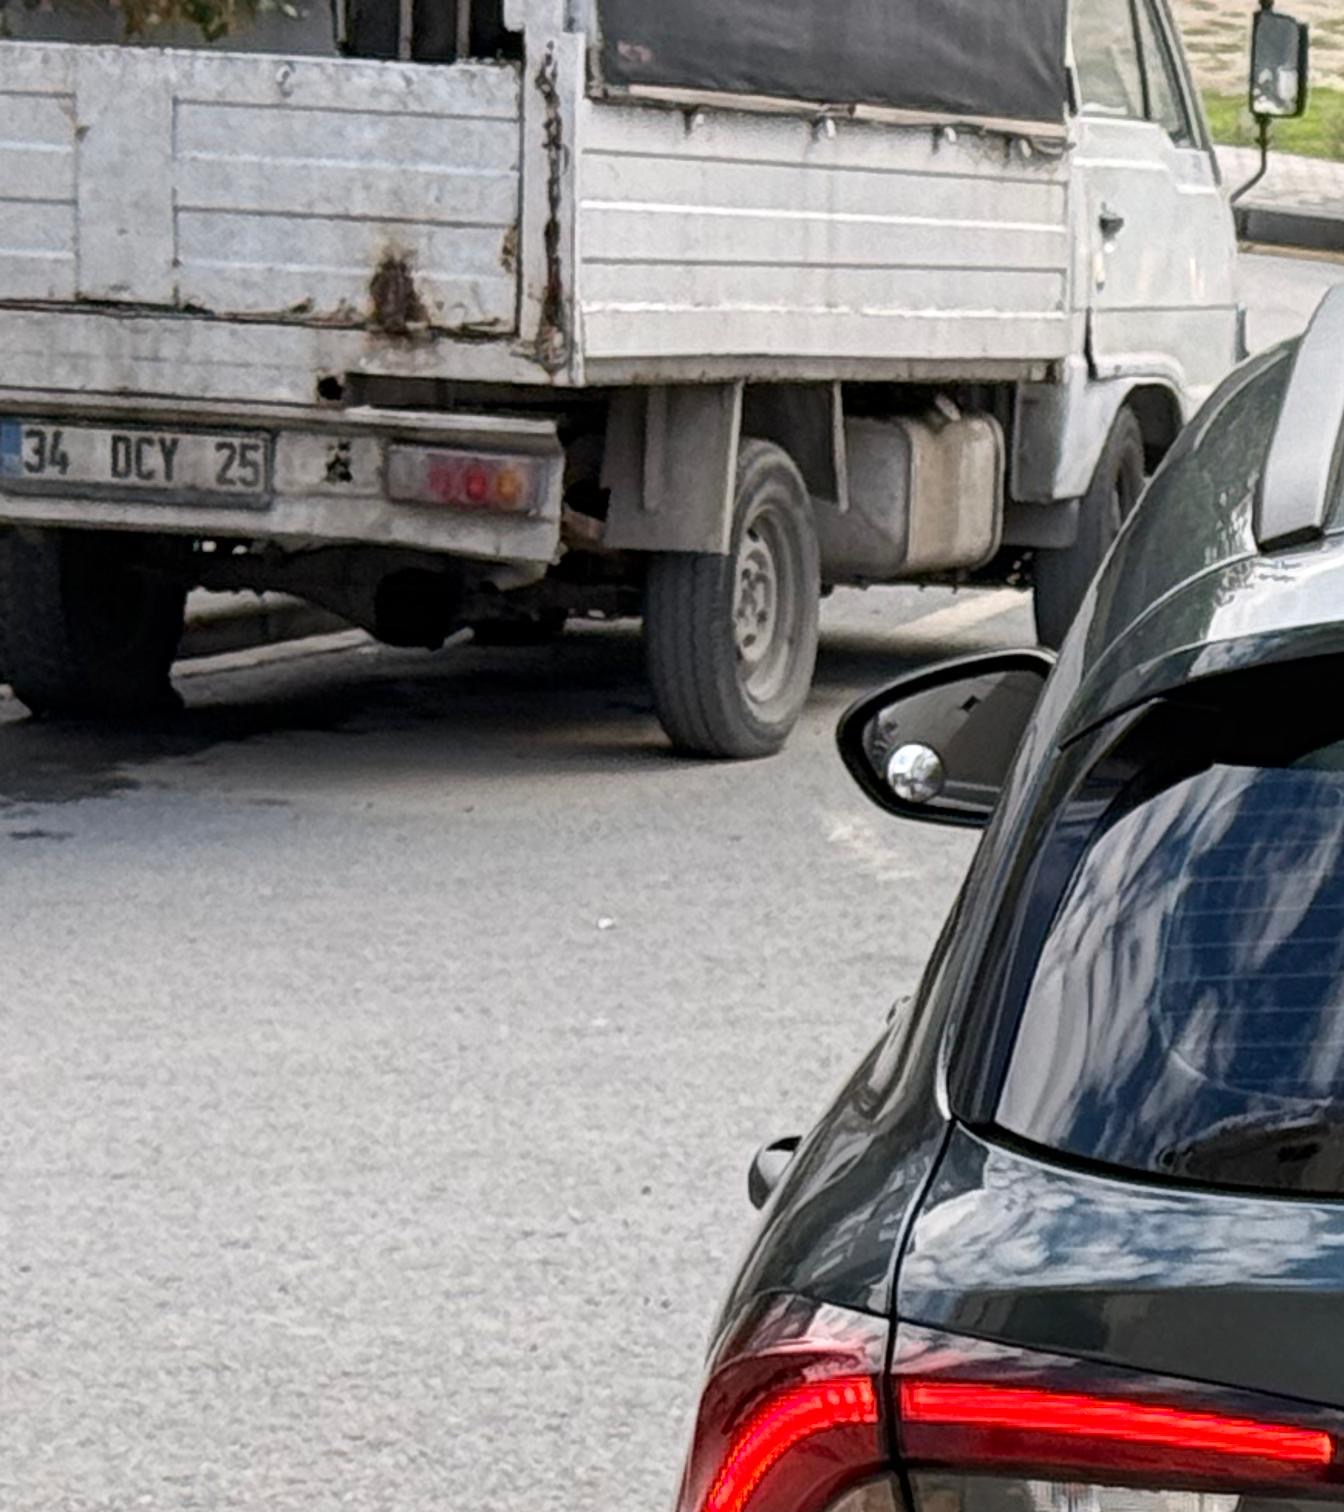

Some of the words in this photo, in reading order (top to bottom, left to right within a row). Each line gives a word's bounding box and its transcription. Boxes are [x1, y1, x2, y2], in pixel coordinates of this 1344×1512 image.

[24, 429, 69, 475] 34
[110, 433, 179, 482] DCY
[214, 440, 261, 487] 25
